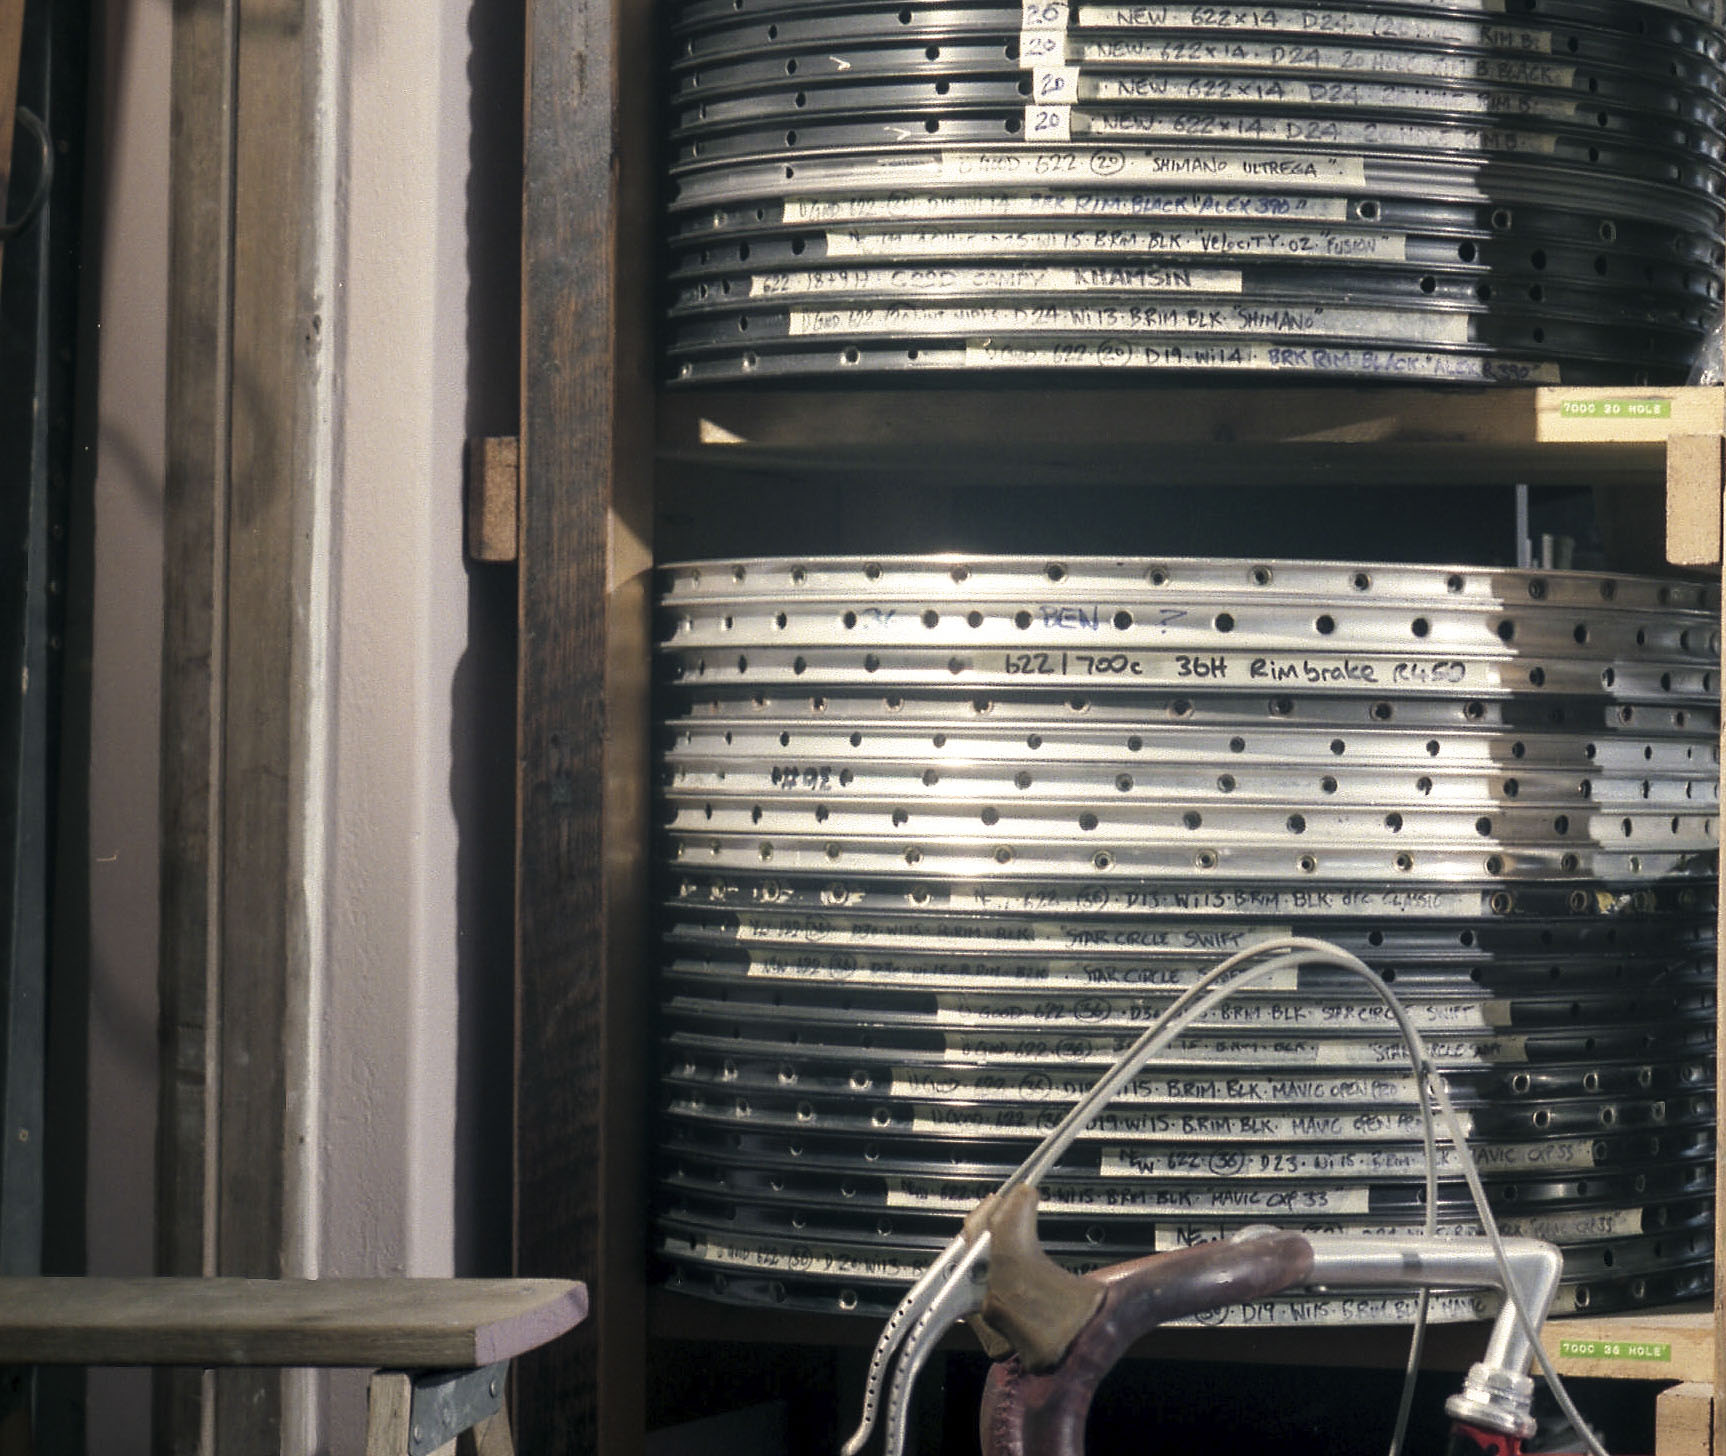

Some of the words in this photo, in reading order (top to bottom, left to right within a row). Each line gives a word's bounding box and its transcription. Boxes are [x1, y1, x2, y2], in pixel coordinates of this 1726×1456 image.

[1026, 3, 1060, 24] 20
[1117, 11, 1167, 24] NEW
[1024, 38, 1056, 56] 20
[1096, 40, 1143, 56] NEW
[1040, 74, 1065, 96] 20
[1118, 80, 1168, 94] NEW
[1034, 112, 1060, 131] 20
[1104, 114, 1154, 130] NEW
[891, 271, 957, 288] GOOD
[1176, 655, 1228, 678] 36H
[1393, 661, 1466, 683] R450
[1114, 930, 1169, 946] CIRCLE
[1184, 931, 1245, 948] SWIFT
[1124, 970, 1179, 984] CIRCLE
[1168, 1150, 1199, 1169] 622
[1259, 1154, 1297, 1171] D23
